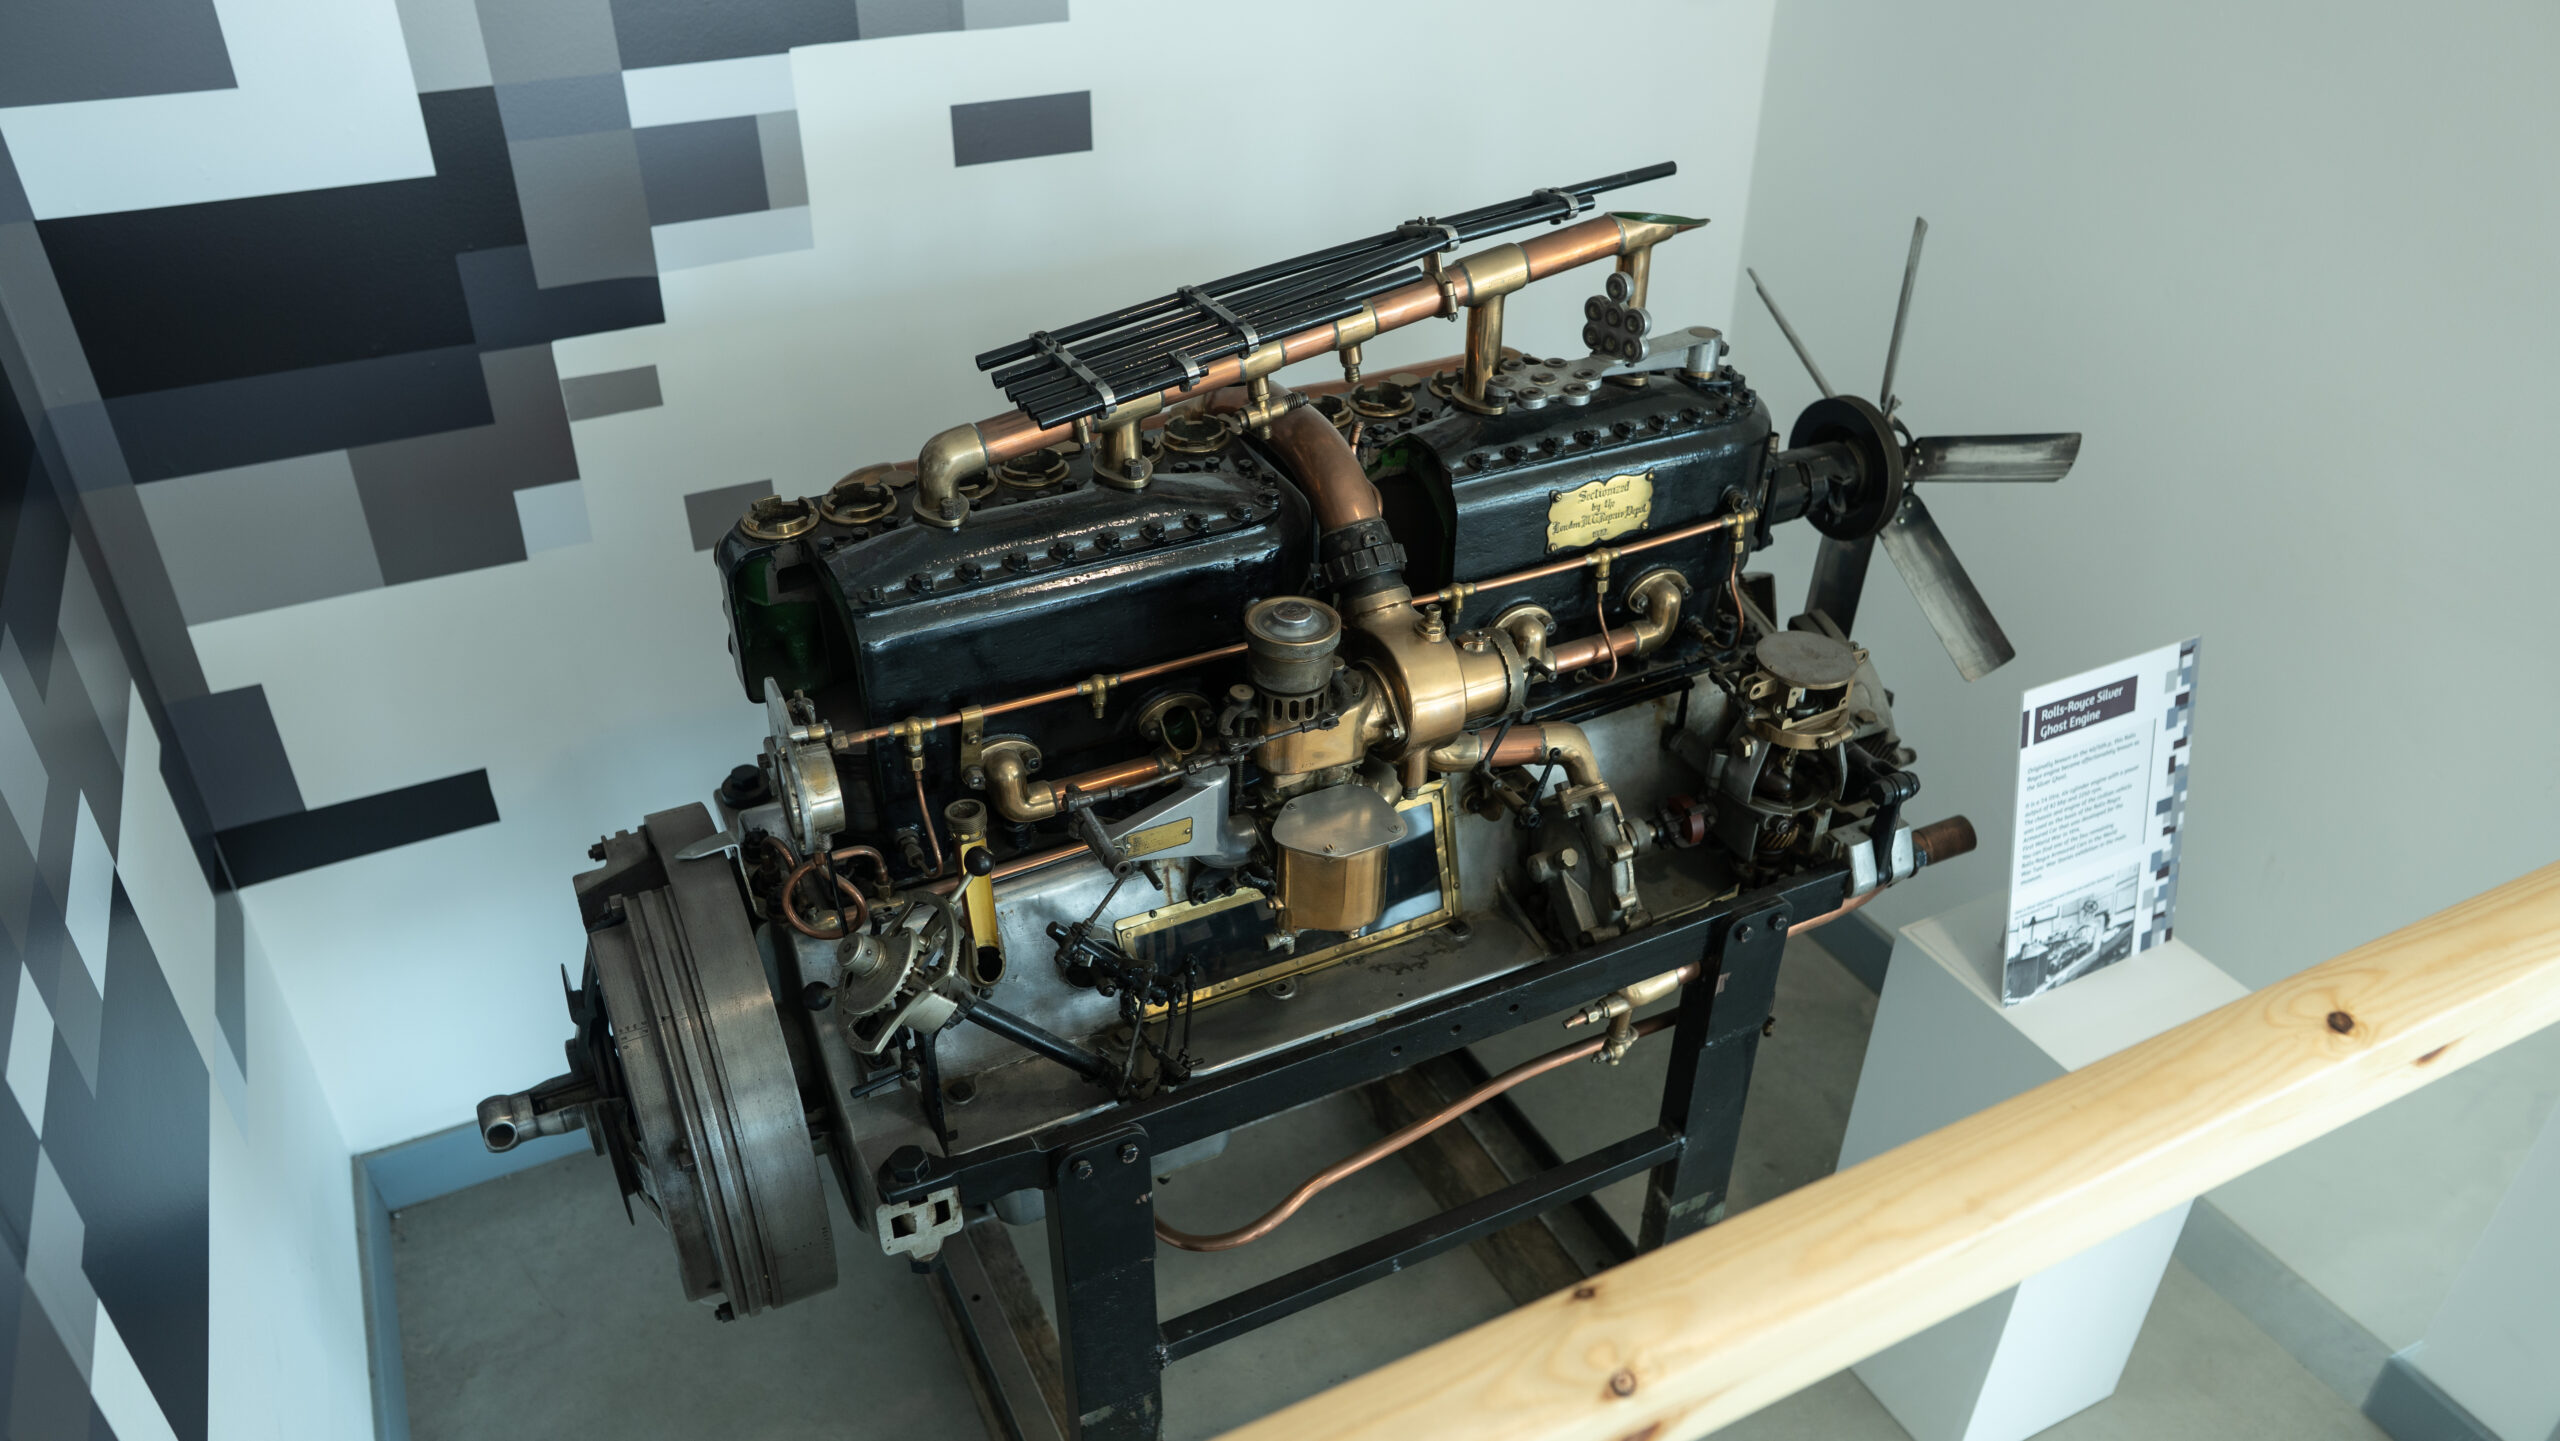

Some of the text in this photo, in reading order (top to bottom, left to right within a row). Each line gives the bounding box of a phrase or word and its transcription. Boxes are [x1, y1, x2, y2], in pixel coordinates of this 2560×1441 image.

[2041, 686, 2124, 721] Rolls-Royce Silver
[2040, 709, 2101, 739] Ghost Engine
